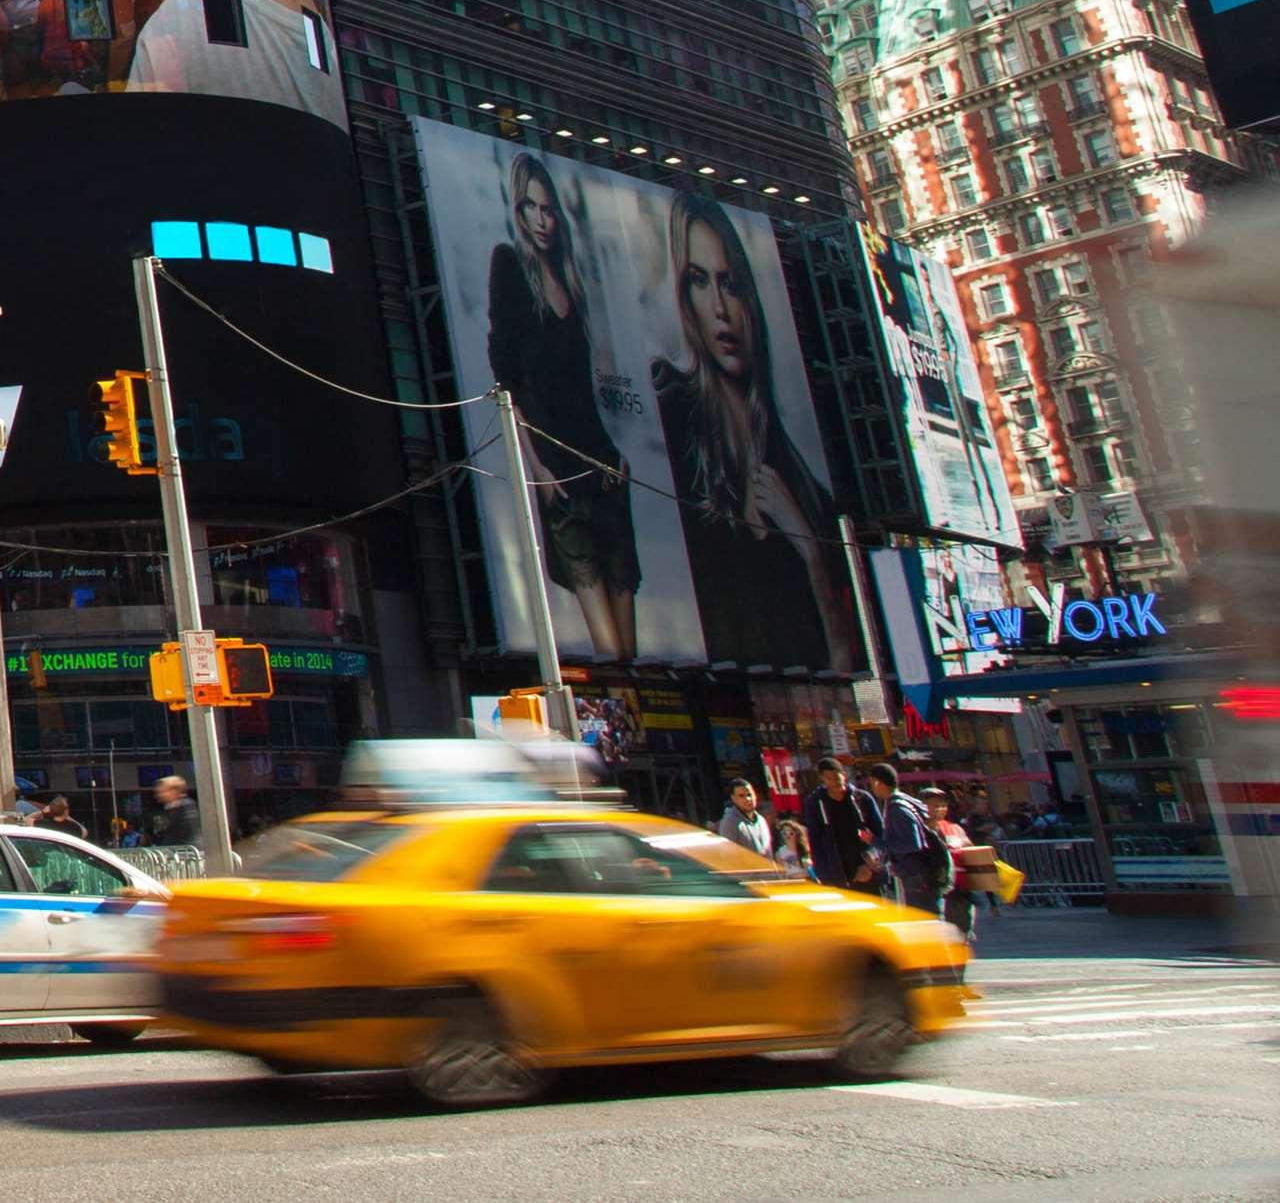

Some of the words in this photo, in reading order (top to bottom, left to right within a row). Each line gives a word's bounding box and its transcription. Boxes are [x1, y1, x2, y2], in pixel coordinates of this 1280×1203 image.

[923, 595, 1023, 656] NEW
[1025, 583, 1167, 644] YORK
[7, 654, 29, 672] #1
[42, 652, 118, 671] XCHANGE
[121, 652, 145, 669] for
[270, 652, 291, 668] ate
[293, 652, 305, 668] in
[306, 652, 334, 670] 2014
